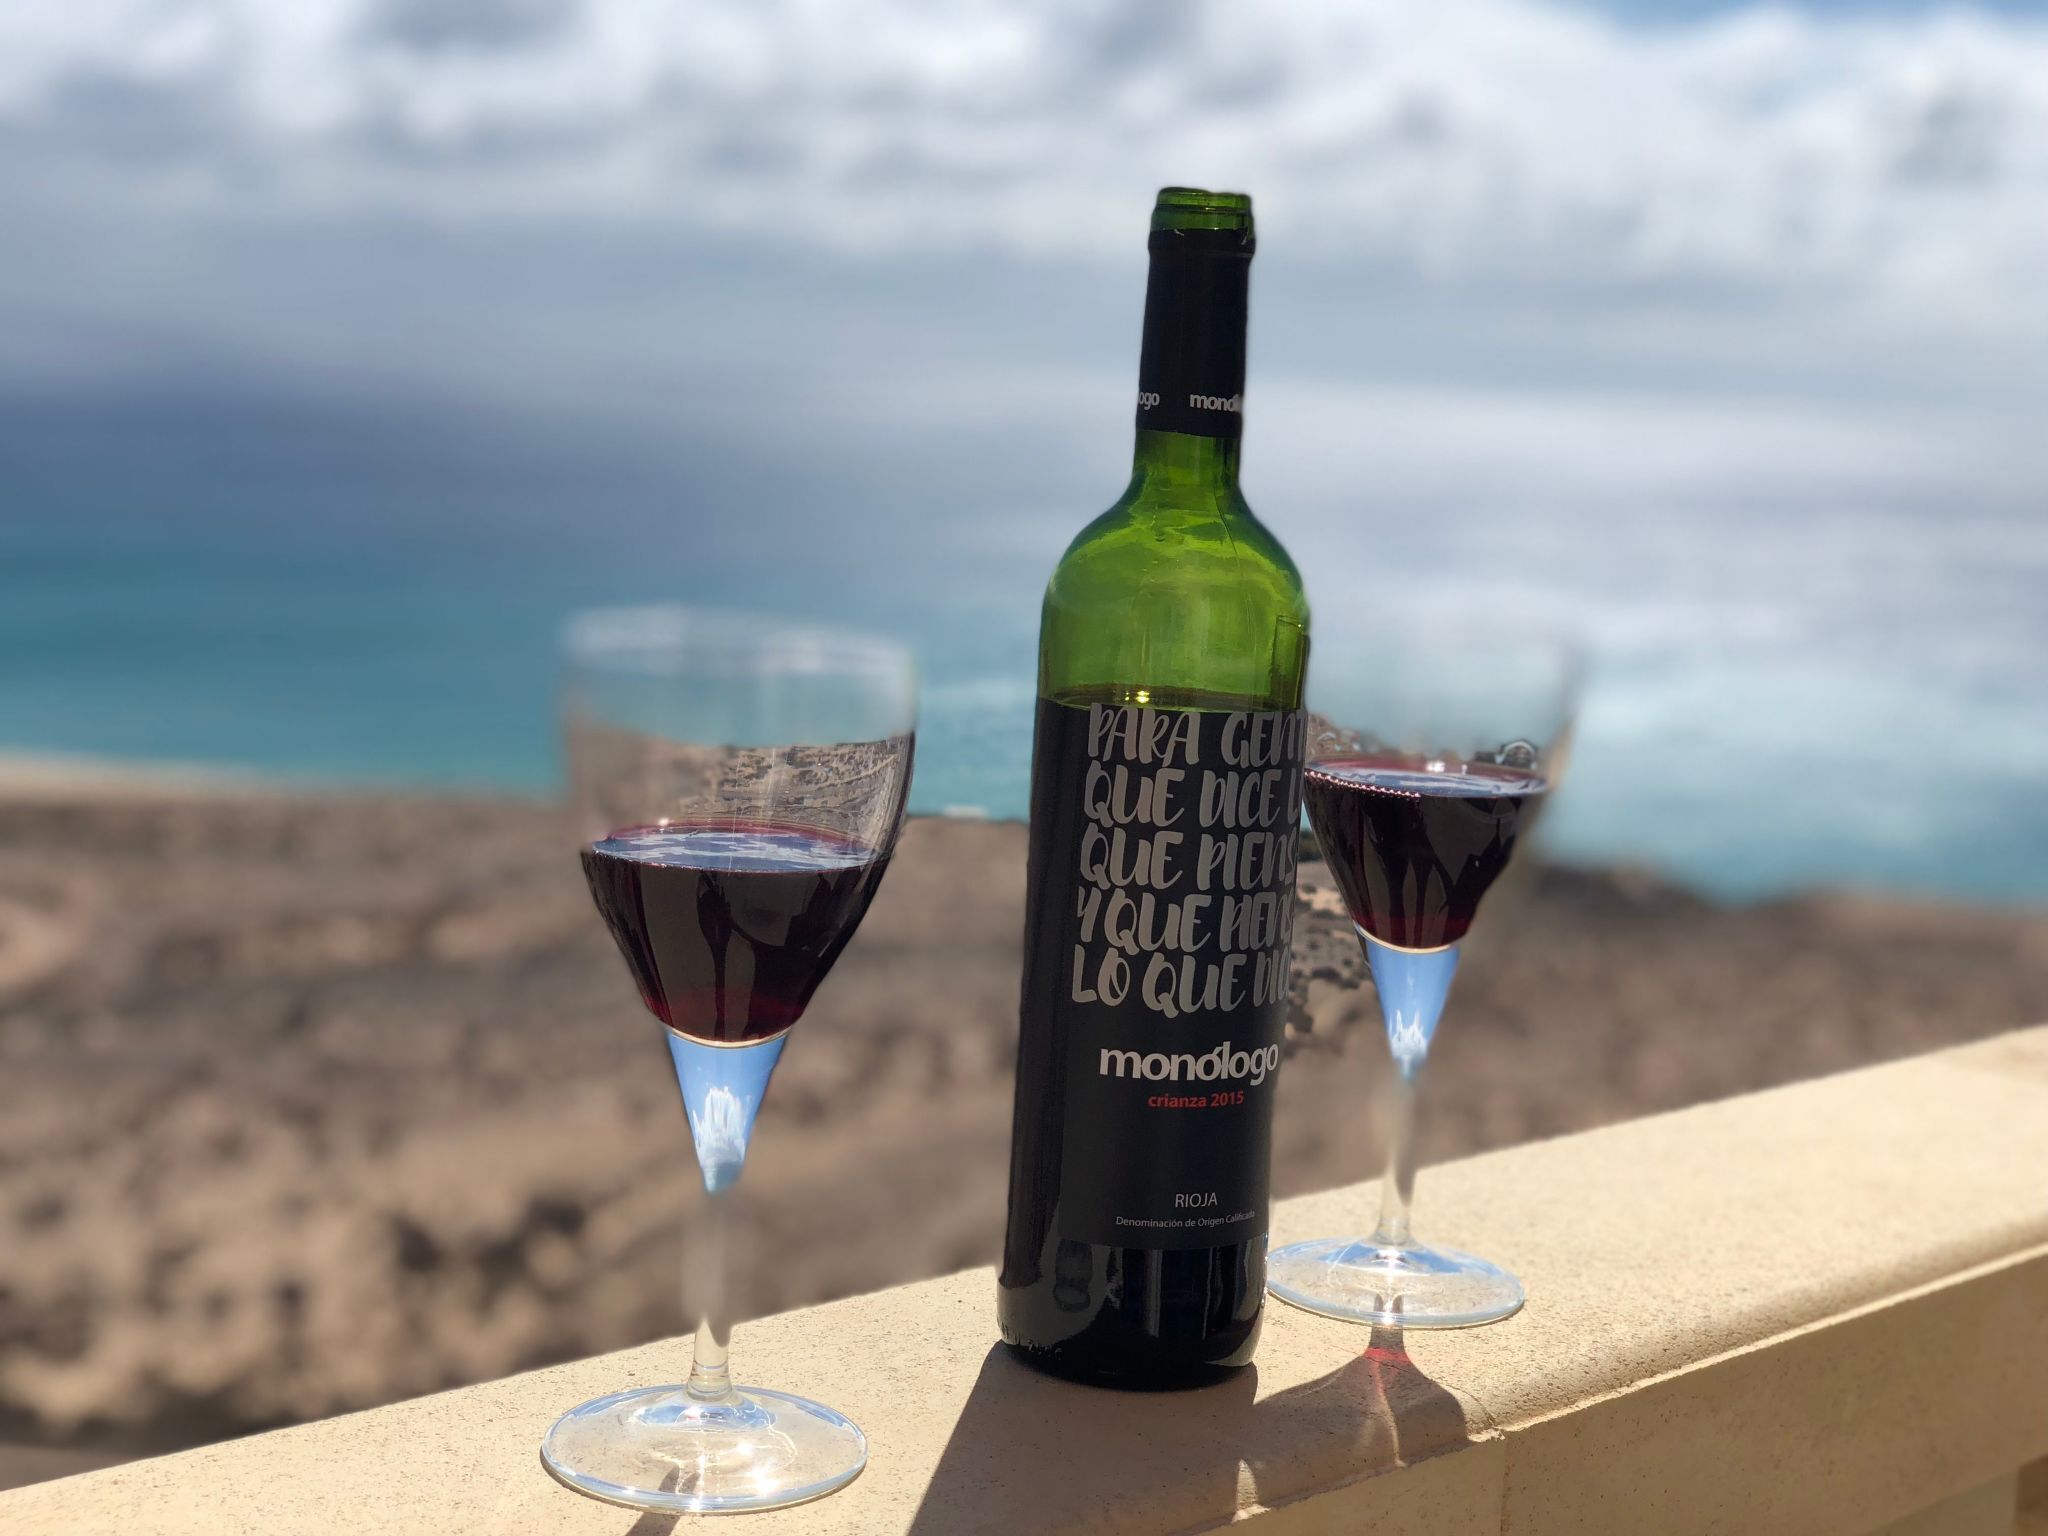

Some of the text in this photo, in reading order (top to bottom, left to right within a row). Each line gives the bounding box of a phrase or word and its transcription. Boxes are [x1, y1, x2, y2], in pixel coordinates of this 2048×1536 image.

[1087, 702, 1202, 767] PARA
[1083, 759, 1185, 828] QUE
[1199, 767, 1281, 828] DICE
[1080, 822, 1184, 890] QUE
[1076, 885, 1102, 943] Y
[1103, 888, 1212, 956] QUE
[1071, 943, 1131, 1007] LO
[1141, 951, 1247, 1019] QUE
[1099, 1040, 1279, 1086] monólogo
[1147, 1090, 1245, 1109] crianza 2015
[1115, 1216, 1183, 1229] Denominación
[1184, 1218, 1196, 1227] de
[1197, 1216, 1225, 1228] Origen
[1174, 1192, 1218, 1208] RIOJA
